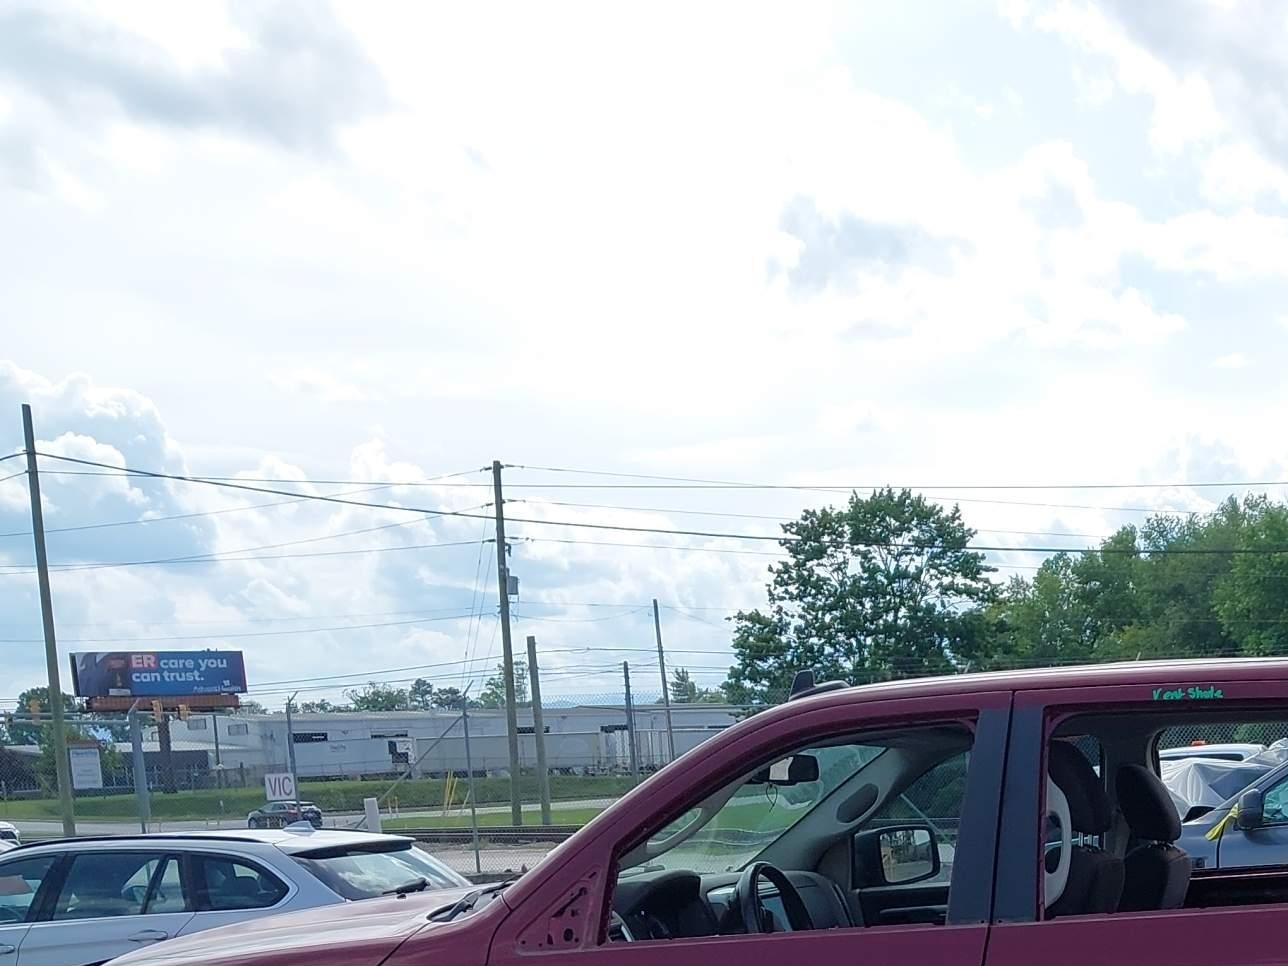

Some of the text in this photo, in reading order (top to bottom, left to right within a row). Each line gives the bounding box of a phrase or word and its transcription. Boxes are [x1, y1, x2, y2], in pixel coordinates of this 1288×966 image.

[131, 654, 227, 671] ER care you
[132, 668, 204, 682] can trust.
[268, 776, 293, 796] VIC
